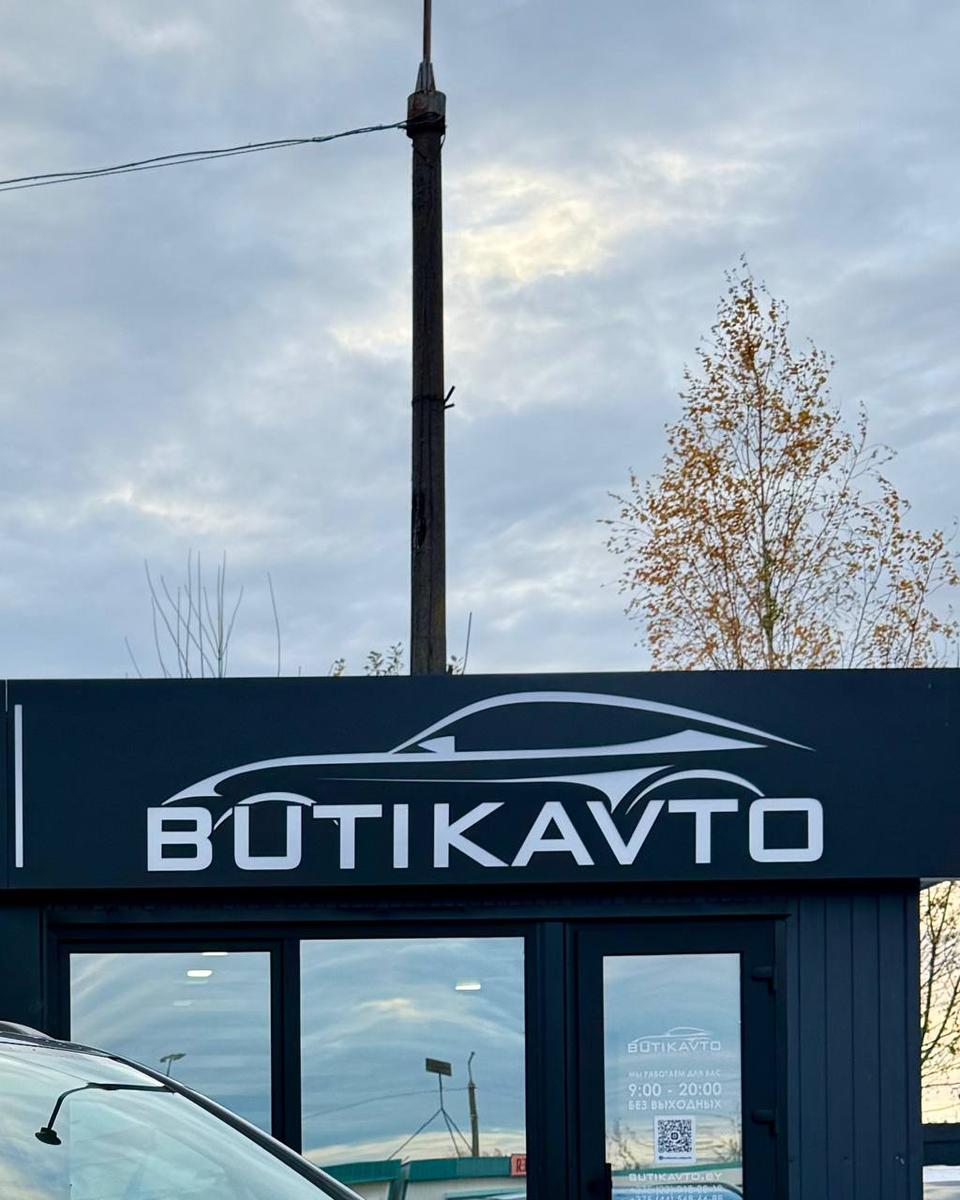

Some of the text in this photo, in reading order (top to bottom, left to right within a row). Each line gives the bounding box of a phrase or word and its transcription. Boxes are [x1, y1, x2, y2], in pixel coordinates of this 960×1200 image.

[147, 797, 824, 872] BUTIKAVTO
[628, 1041, 721, 1053] BUTIKAVTO
[628, 1083, 661, 1097] 9:00
[679, 1082, 722, 1096] 20:00
[628, 1099, 721, 1110] БЕЗ ВЫХОДНЫХ
[628, 1173, 722, 1182] BUTIKAVTO.BY
